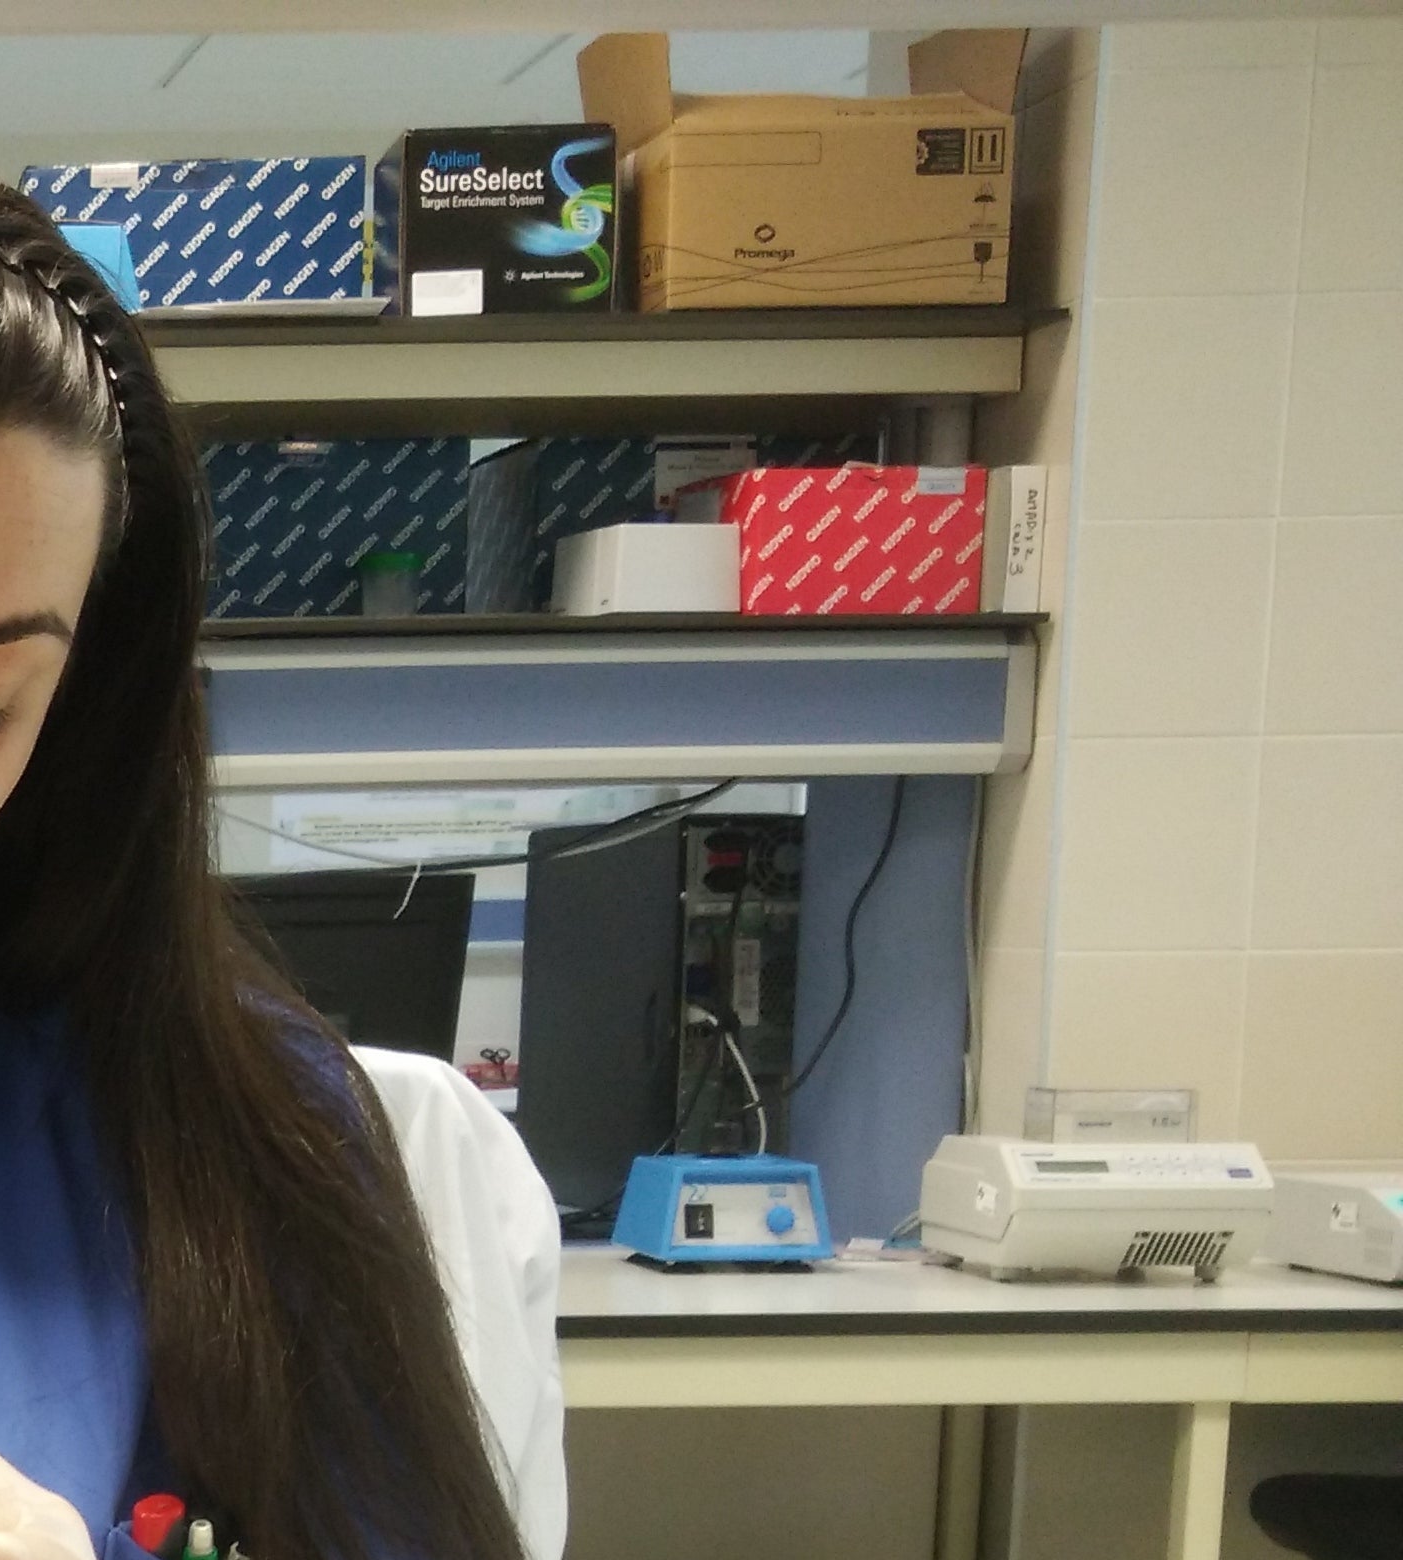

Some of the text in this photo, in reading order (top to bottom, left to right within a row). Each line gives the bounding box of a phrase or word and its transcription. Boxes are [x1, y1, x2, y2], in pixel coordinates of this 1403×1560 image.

[420, 166, 544, 193] SureSelect
[428, 151, 481, 171] Agilent
[200, 174, 235, 211] QIAGEN
[321, 163, 357, 200] QIAGEN
[152, 193, 188, 231] QIAGEN
[274, 183, 309, 220] QIAGEN
[421, 194, 544, 210] Target Enrichment System
[228, 202, 263, 239] QIAGEN
[301, 211, 337, 249] QIAGEN
[180, 221, 216, 259] QIAGEN
[256, 230, 291, 267] QIAGEN
[734, 247, 795, 261] Promega
[135, 241, 170, 278] QIAGEN
[208, 250, 243, 287] QIAGEN
[283, 259, 319, 296] QIAGEN
[329, 240, 364, 278] QIAGEN
[521, 271, 584, 280] Agilent Technologies
[162, 269, 197, 306] QIAGEN
[806, 505, 841, 542] QIAGEN
[853, 487, 889, 524] QIAGEN
[928, 499, 964, 534] QIAGEN
[758, 523, 794, 561] QIAGEN
[881, 517, 917, 553] QIAGEN
[785, 554, 822, 591] QIAGEN
[833, 536, 870, 573] QIAGEN
[908, 547, 944, 584] QIAGEN
[860, 566, 897, 602] QIAGEN
